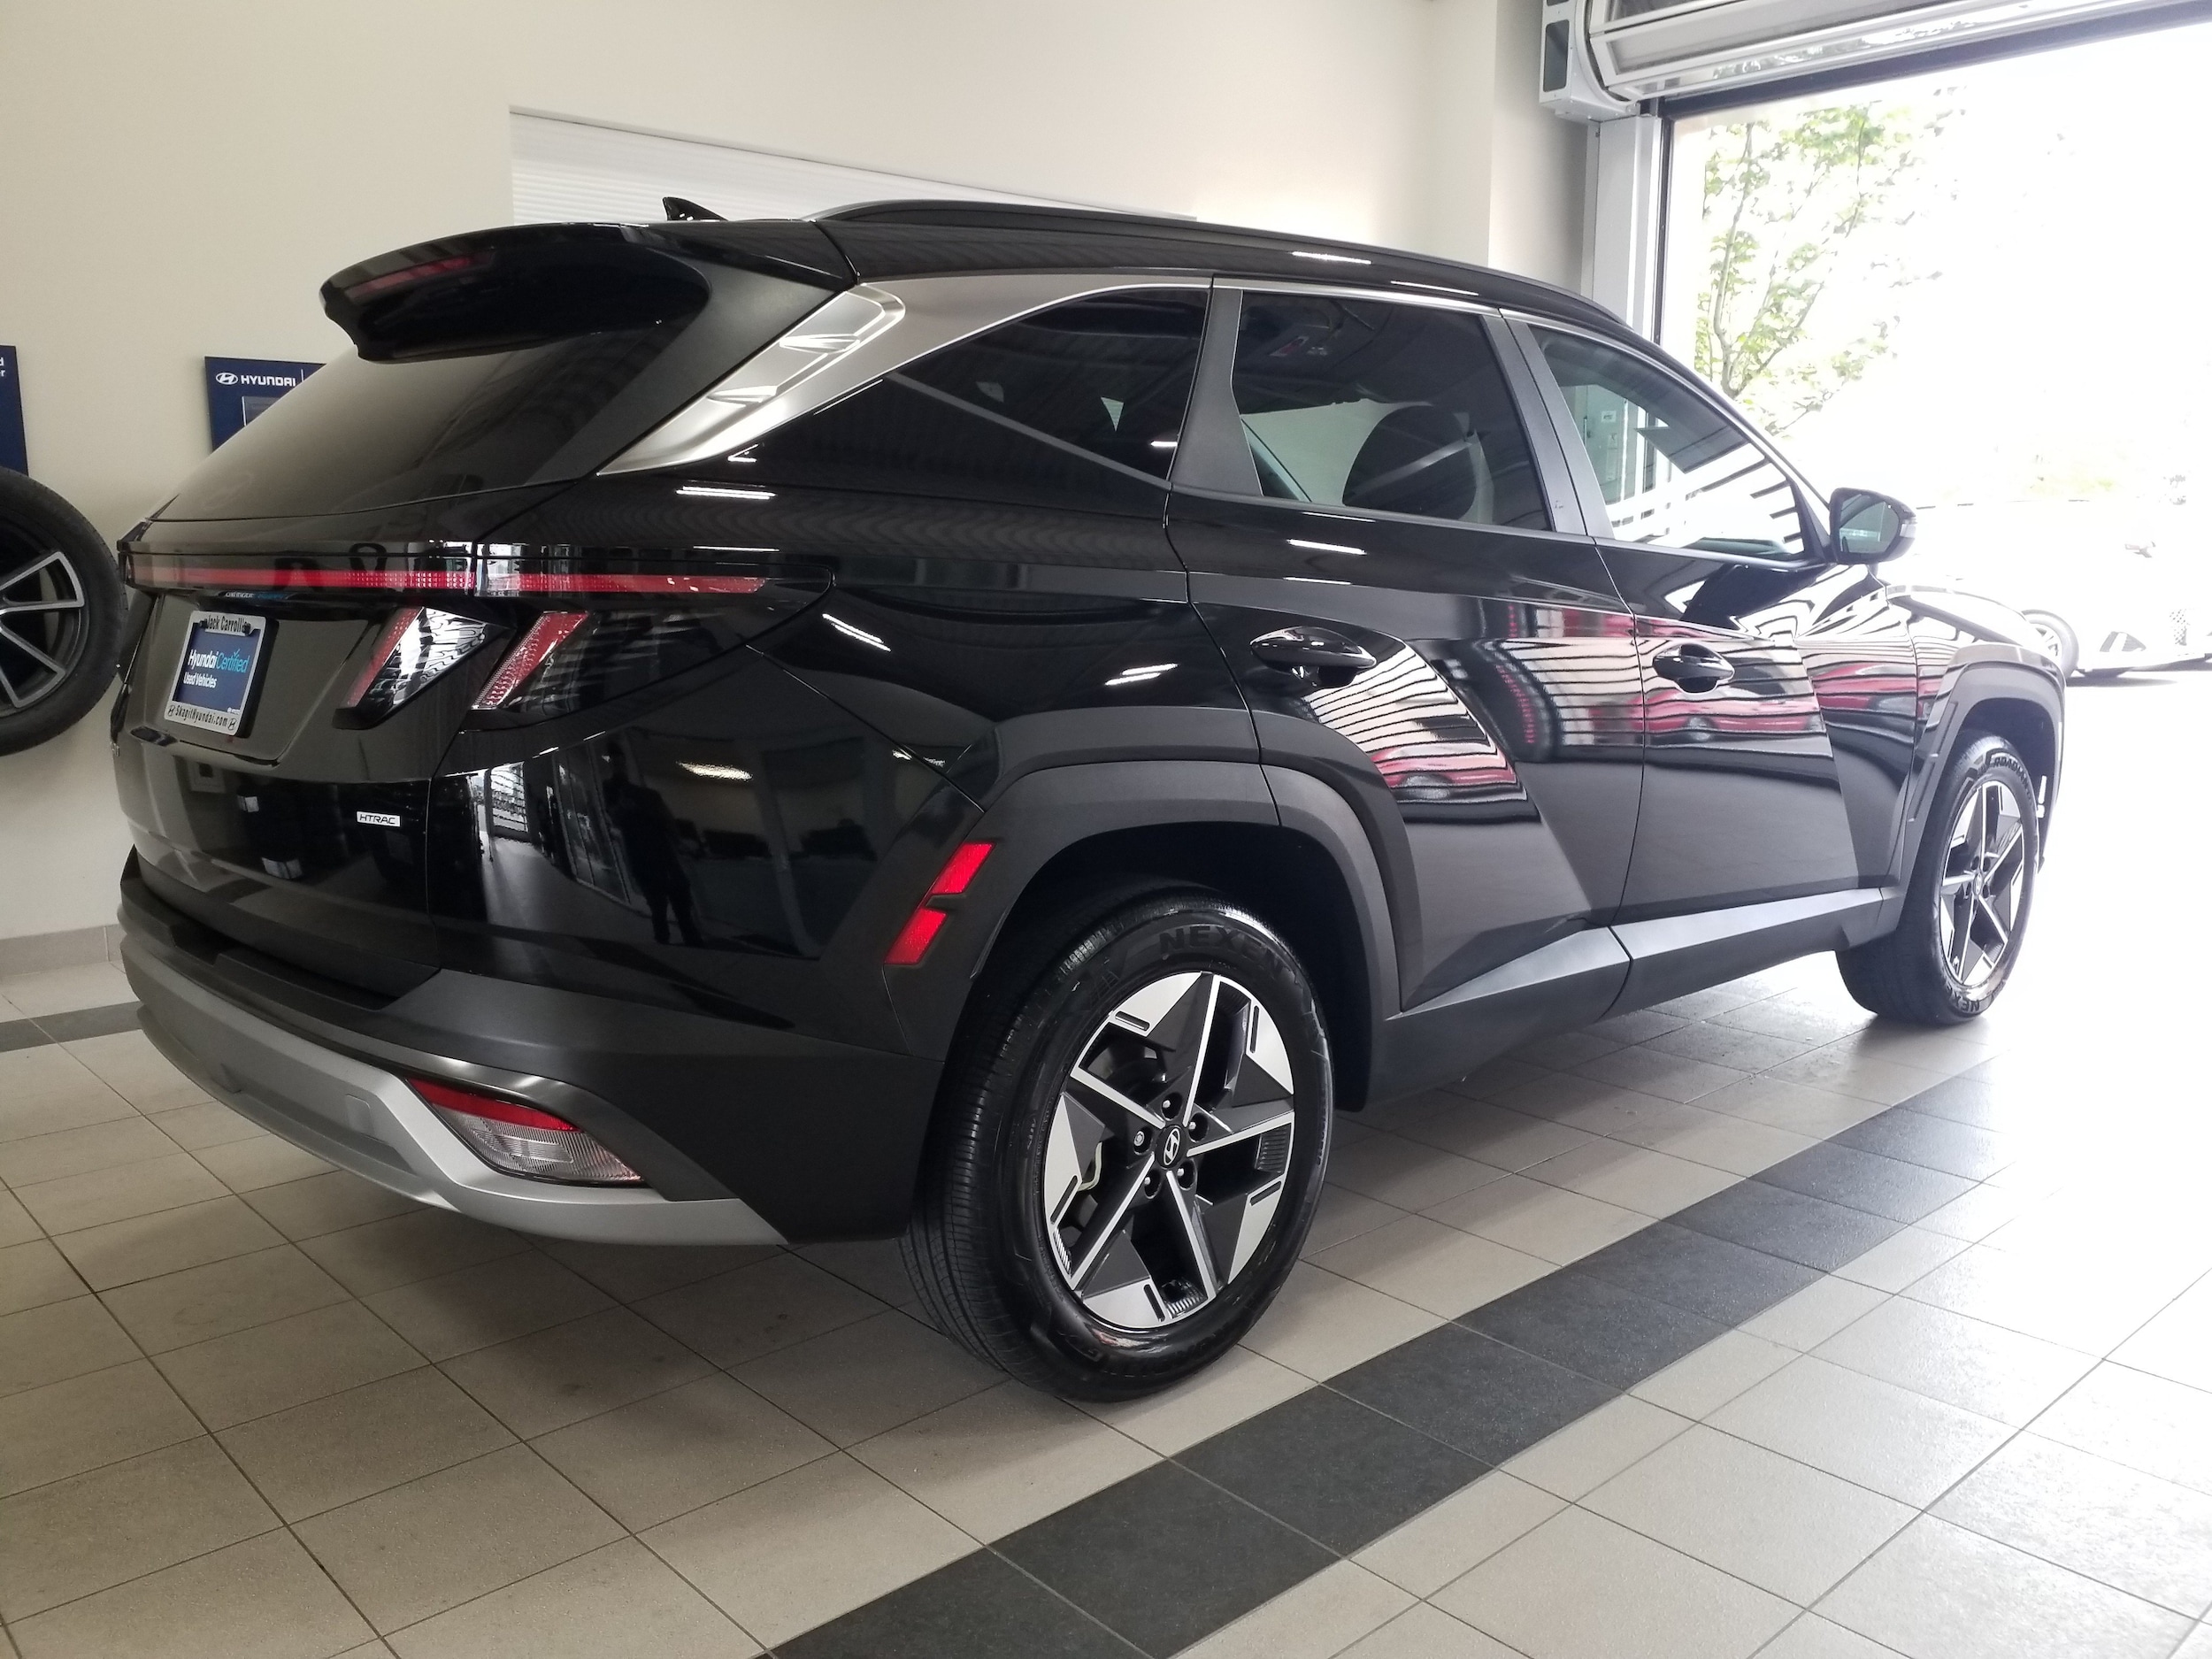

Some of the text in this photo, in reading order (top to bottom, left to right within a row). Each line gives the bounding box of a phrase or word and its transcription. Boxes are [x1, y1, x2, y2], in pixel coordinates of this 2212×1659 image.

[241, 374, 296, 387] HYUNDAI
[183, 672, 218, 688] Used Vehicles
[175, 704, 228, 726] SkagitHyundai.com
[359, 814, 396, 825] HTRAC
[1159, 925, 1282, 978] NEXEN
